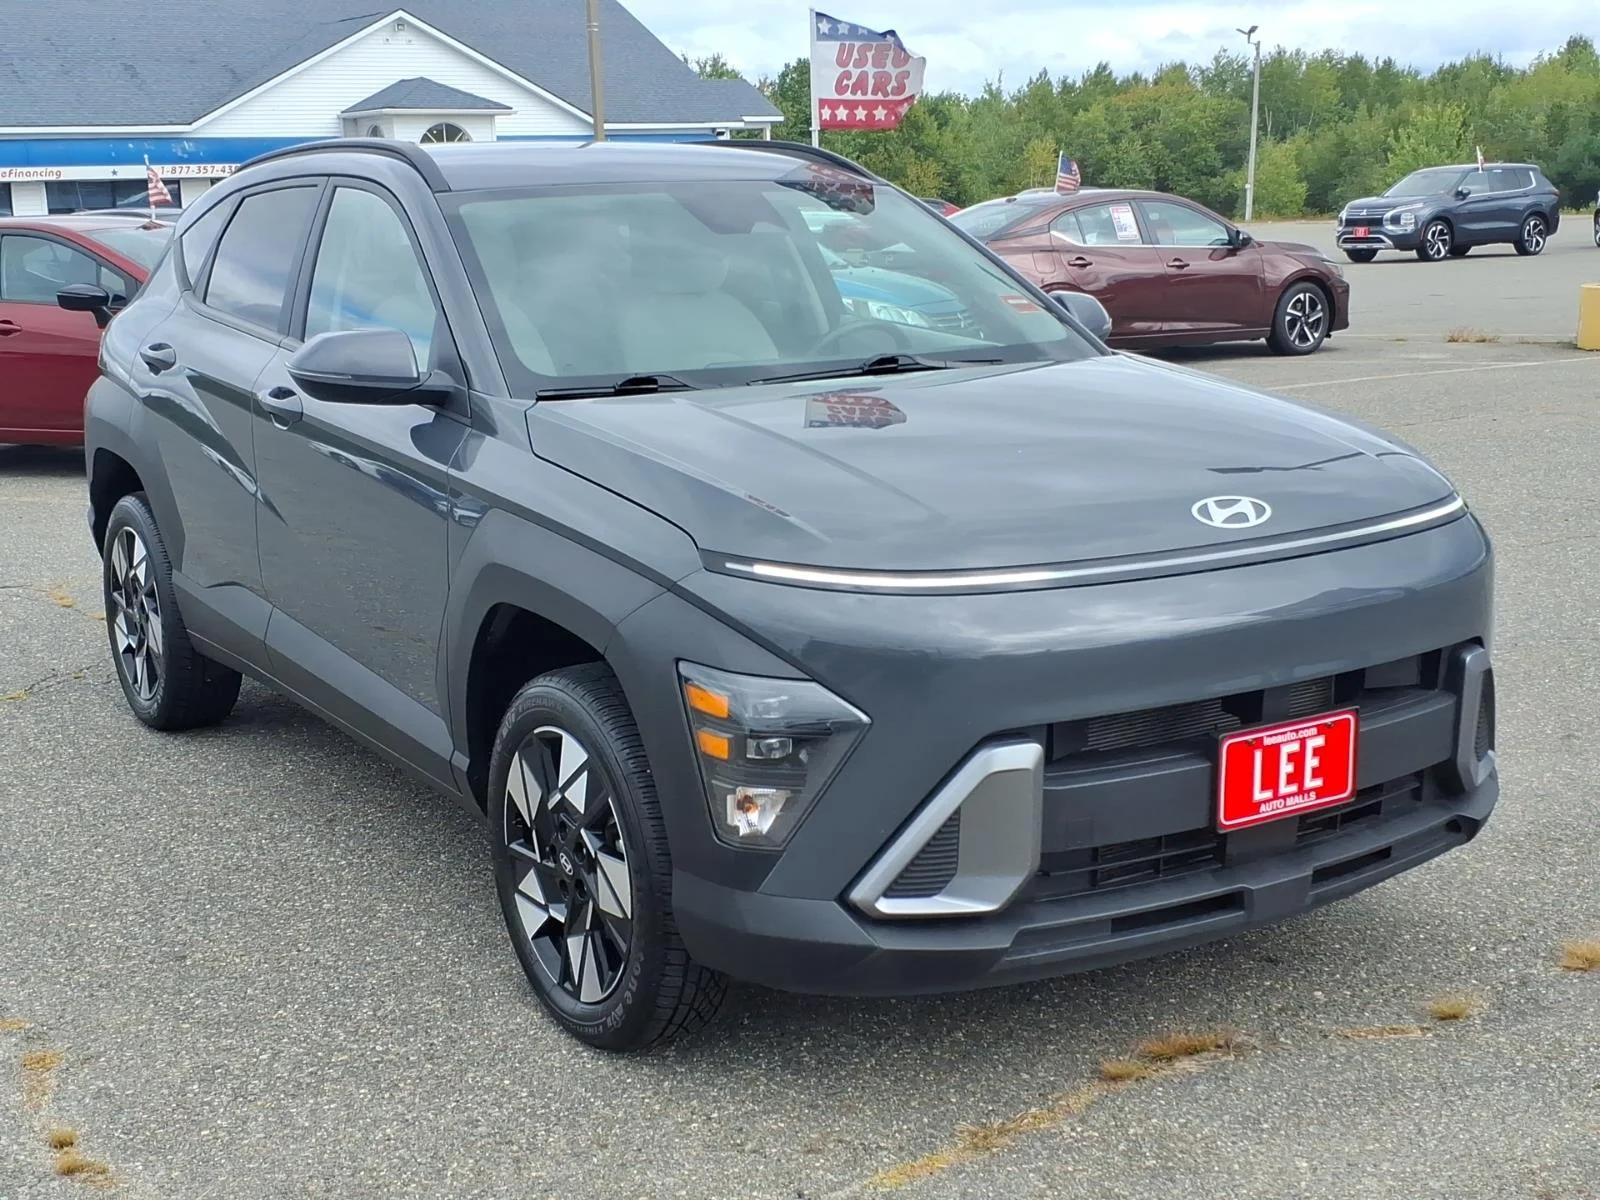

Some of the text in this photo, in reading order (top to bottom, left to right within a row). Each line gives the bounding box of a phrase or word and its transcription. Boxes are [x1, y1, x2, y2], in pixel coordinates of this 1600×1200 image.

[836, 43, 911, 69] USED
[835, 70, 910, 98] CARS
[1263, 728, 1317, 746] leeauto.com
[1253, 735, 1325, 802] LEE
[1260, 791, 1316, 813] AUTO MALLS
